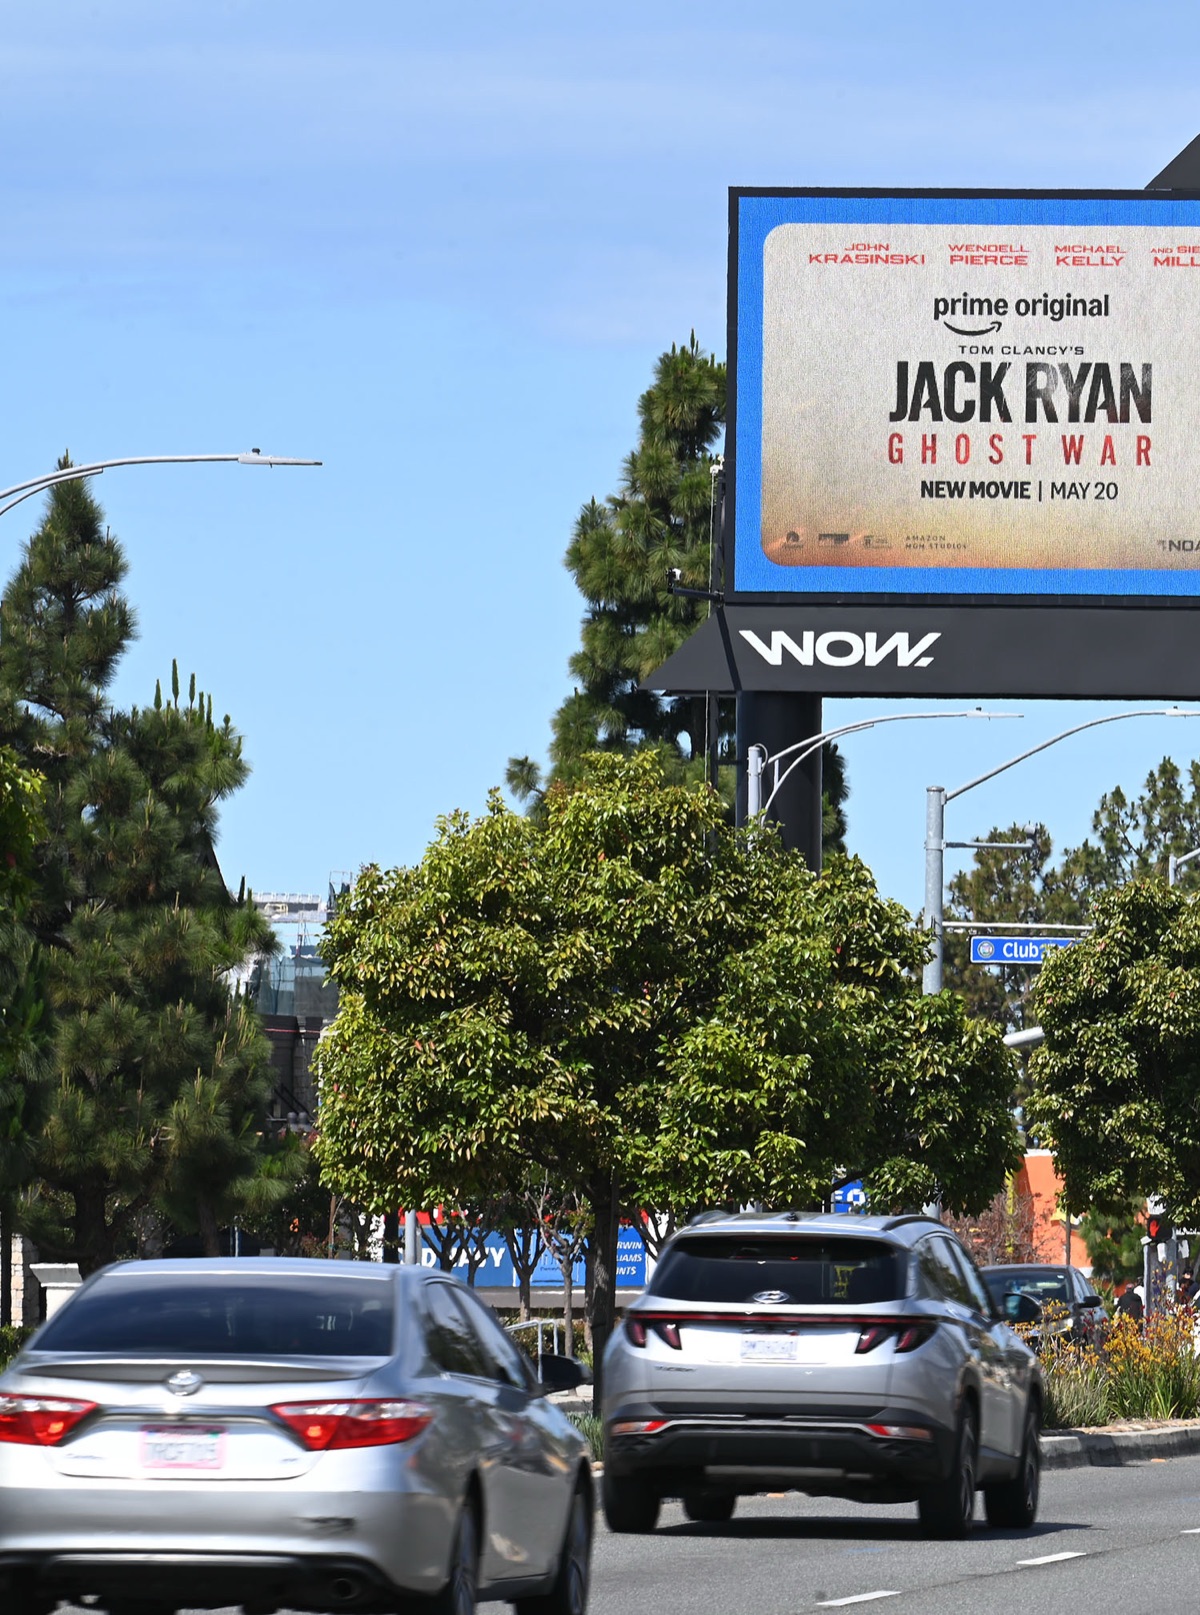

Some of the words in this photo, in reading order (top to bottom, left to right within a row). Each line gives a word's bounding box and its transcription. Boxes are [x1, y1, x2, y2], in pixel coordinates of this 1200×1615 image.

[844, 243, 890, 251] JOHN
[948, 244, 1030, 253] WENDELL
[1054, 245, 1128, 254] MICHAEL
[809, 253, 926, 265] KRASINSKI
[949, 255, 1028, 266] PIERCE
[1056, 256, 1125, 266] KELLY
[934, 292, 1009, 320] prime
[1015, 293, 1110, 321] original
[959, 345, 994, 355] TOM
[1001, 345, 1084, 355] CLANCY'S
[889, 361, 1012, 423] JACK
[1025, 362, 1152, 424] RYAN
[888, 432, 1037, 465] GHOST
[1061, 434, 1152, 466] WAR
[921, 480, 966, 498] NEW
[969, 480, 1031, 499] MOVIE
[1051, 482, 1090, 500] MAY
[1094, 482, 1118, 500] 20
[1003, 942, 1039, 958] Club
[617, 1241, 643, 1249] RWIN
[616, 1254, 643, 1262] LIAMS
[616, 1266, 637, 1275] INTS
